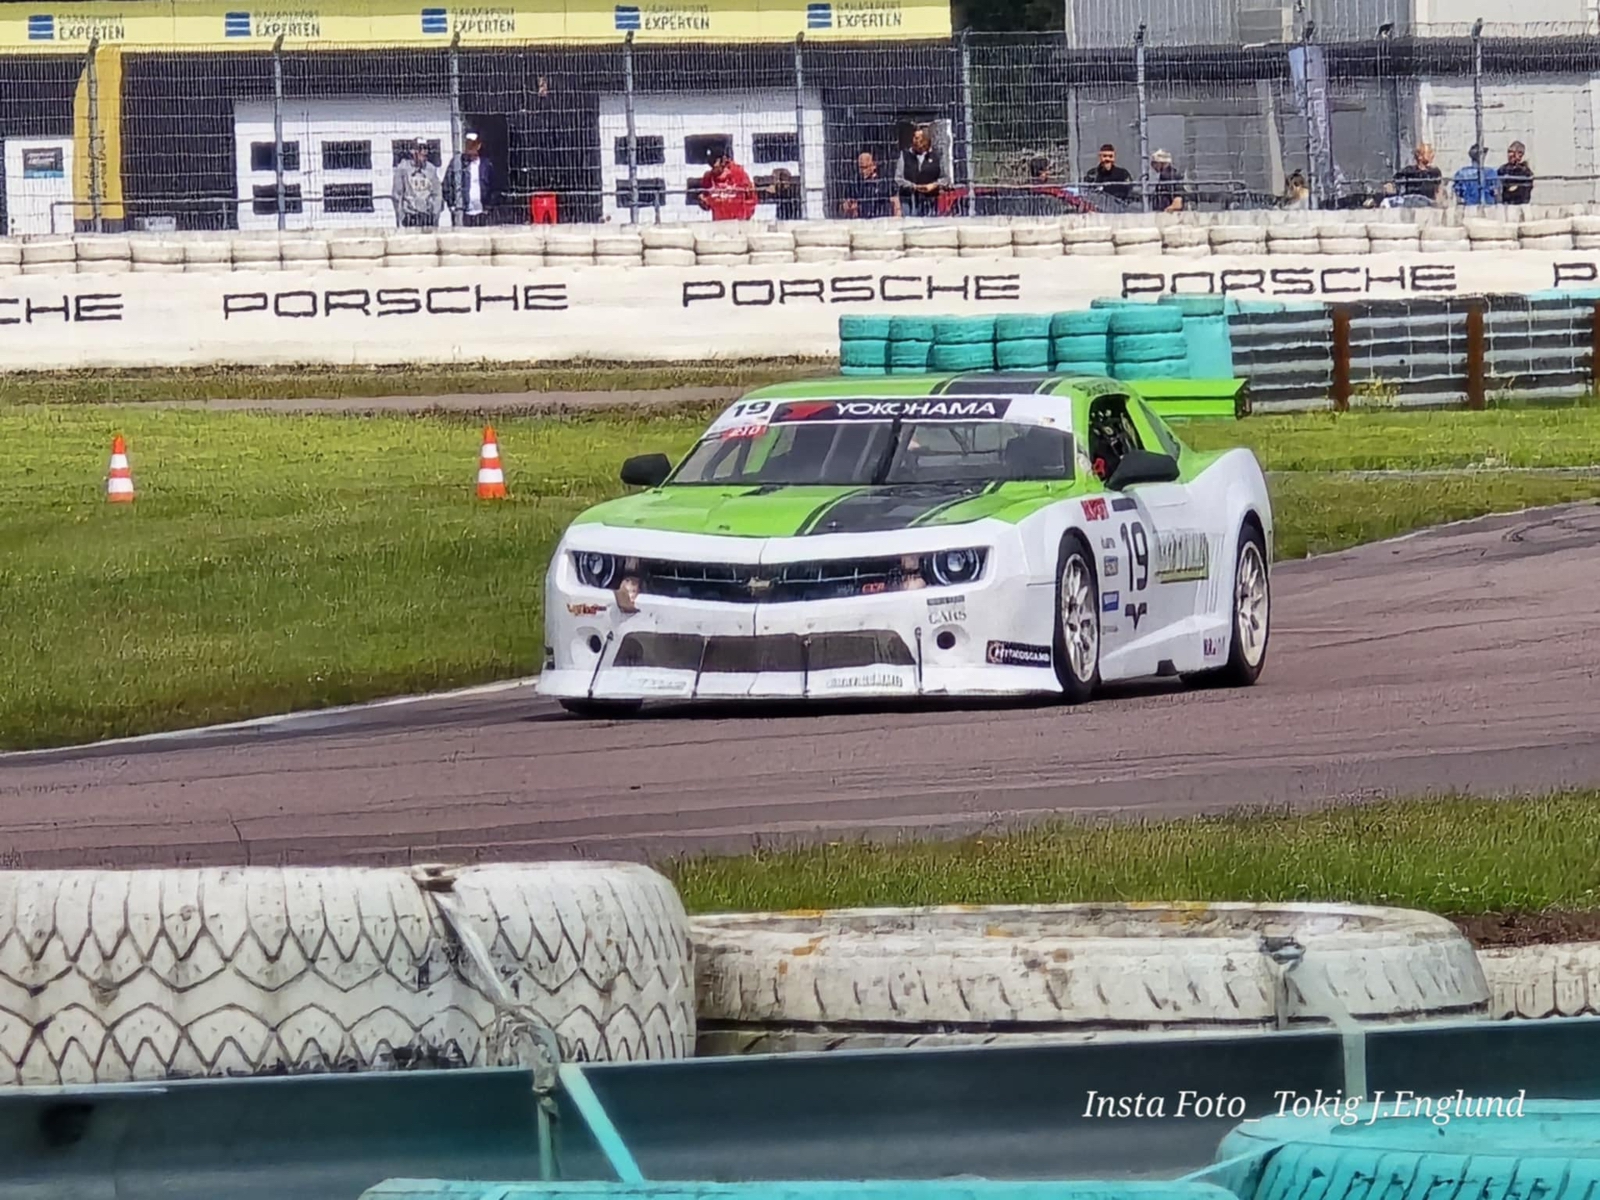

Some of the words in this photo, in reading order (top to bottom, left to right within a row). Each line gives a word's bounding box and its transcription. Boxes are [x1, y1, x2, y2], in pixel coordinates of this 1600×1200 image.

[683, 274, 1020, 308] PORSCHE
[1121, 265, 1456, 298] PORSCHE
[224, 283, 568, 320] PORSCHE
[734, 401, 771, 417] 19
[836, 402, 995, 415] YOKOHAMA
[1120, 521, 1149, 592] 19
